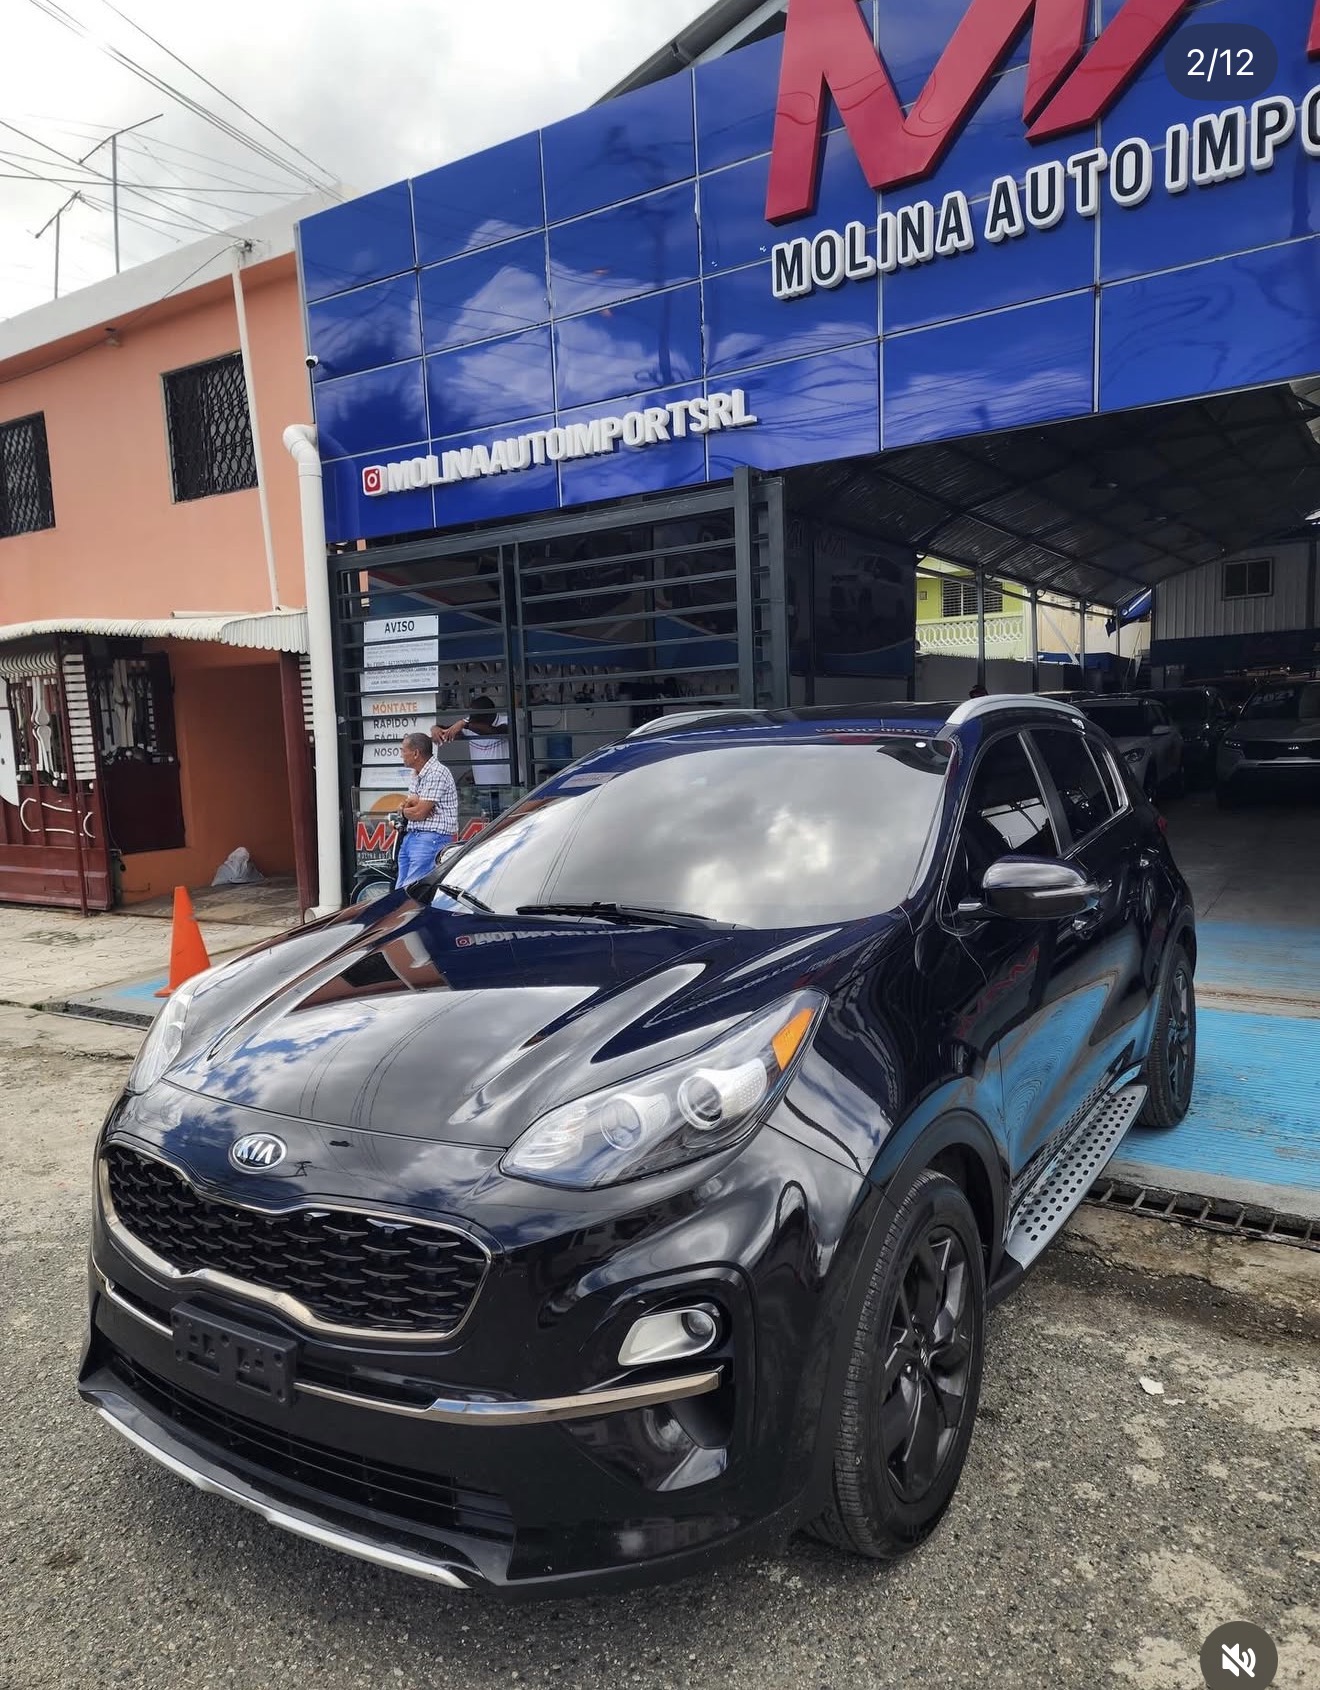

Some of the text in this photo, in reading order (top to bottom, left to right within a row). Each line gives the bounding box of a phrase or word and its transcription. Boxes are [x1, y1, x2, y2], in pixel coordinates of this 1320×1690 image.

[771, 189, 975, 299] MOLINA
[984, 137, 1153, 242] AUTO
[386, 388, 758, 493] MOLINAAUTOIMPORTSRL
[384, 620, 415, 634] AVISO
[372, 701, 418, 714] MÓNTATE
[411, 716, 418, 728] Y
[374, 747, 402, 758] NOSO
[236, 1138, 277, 1165] KIA
